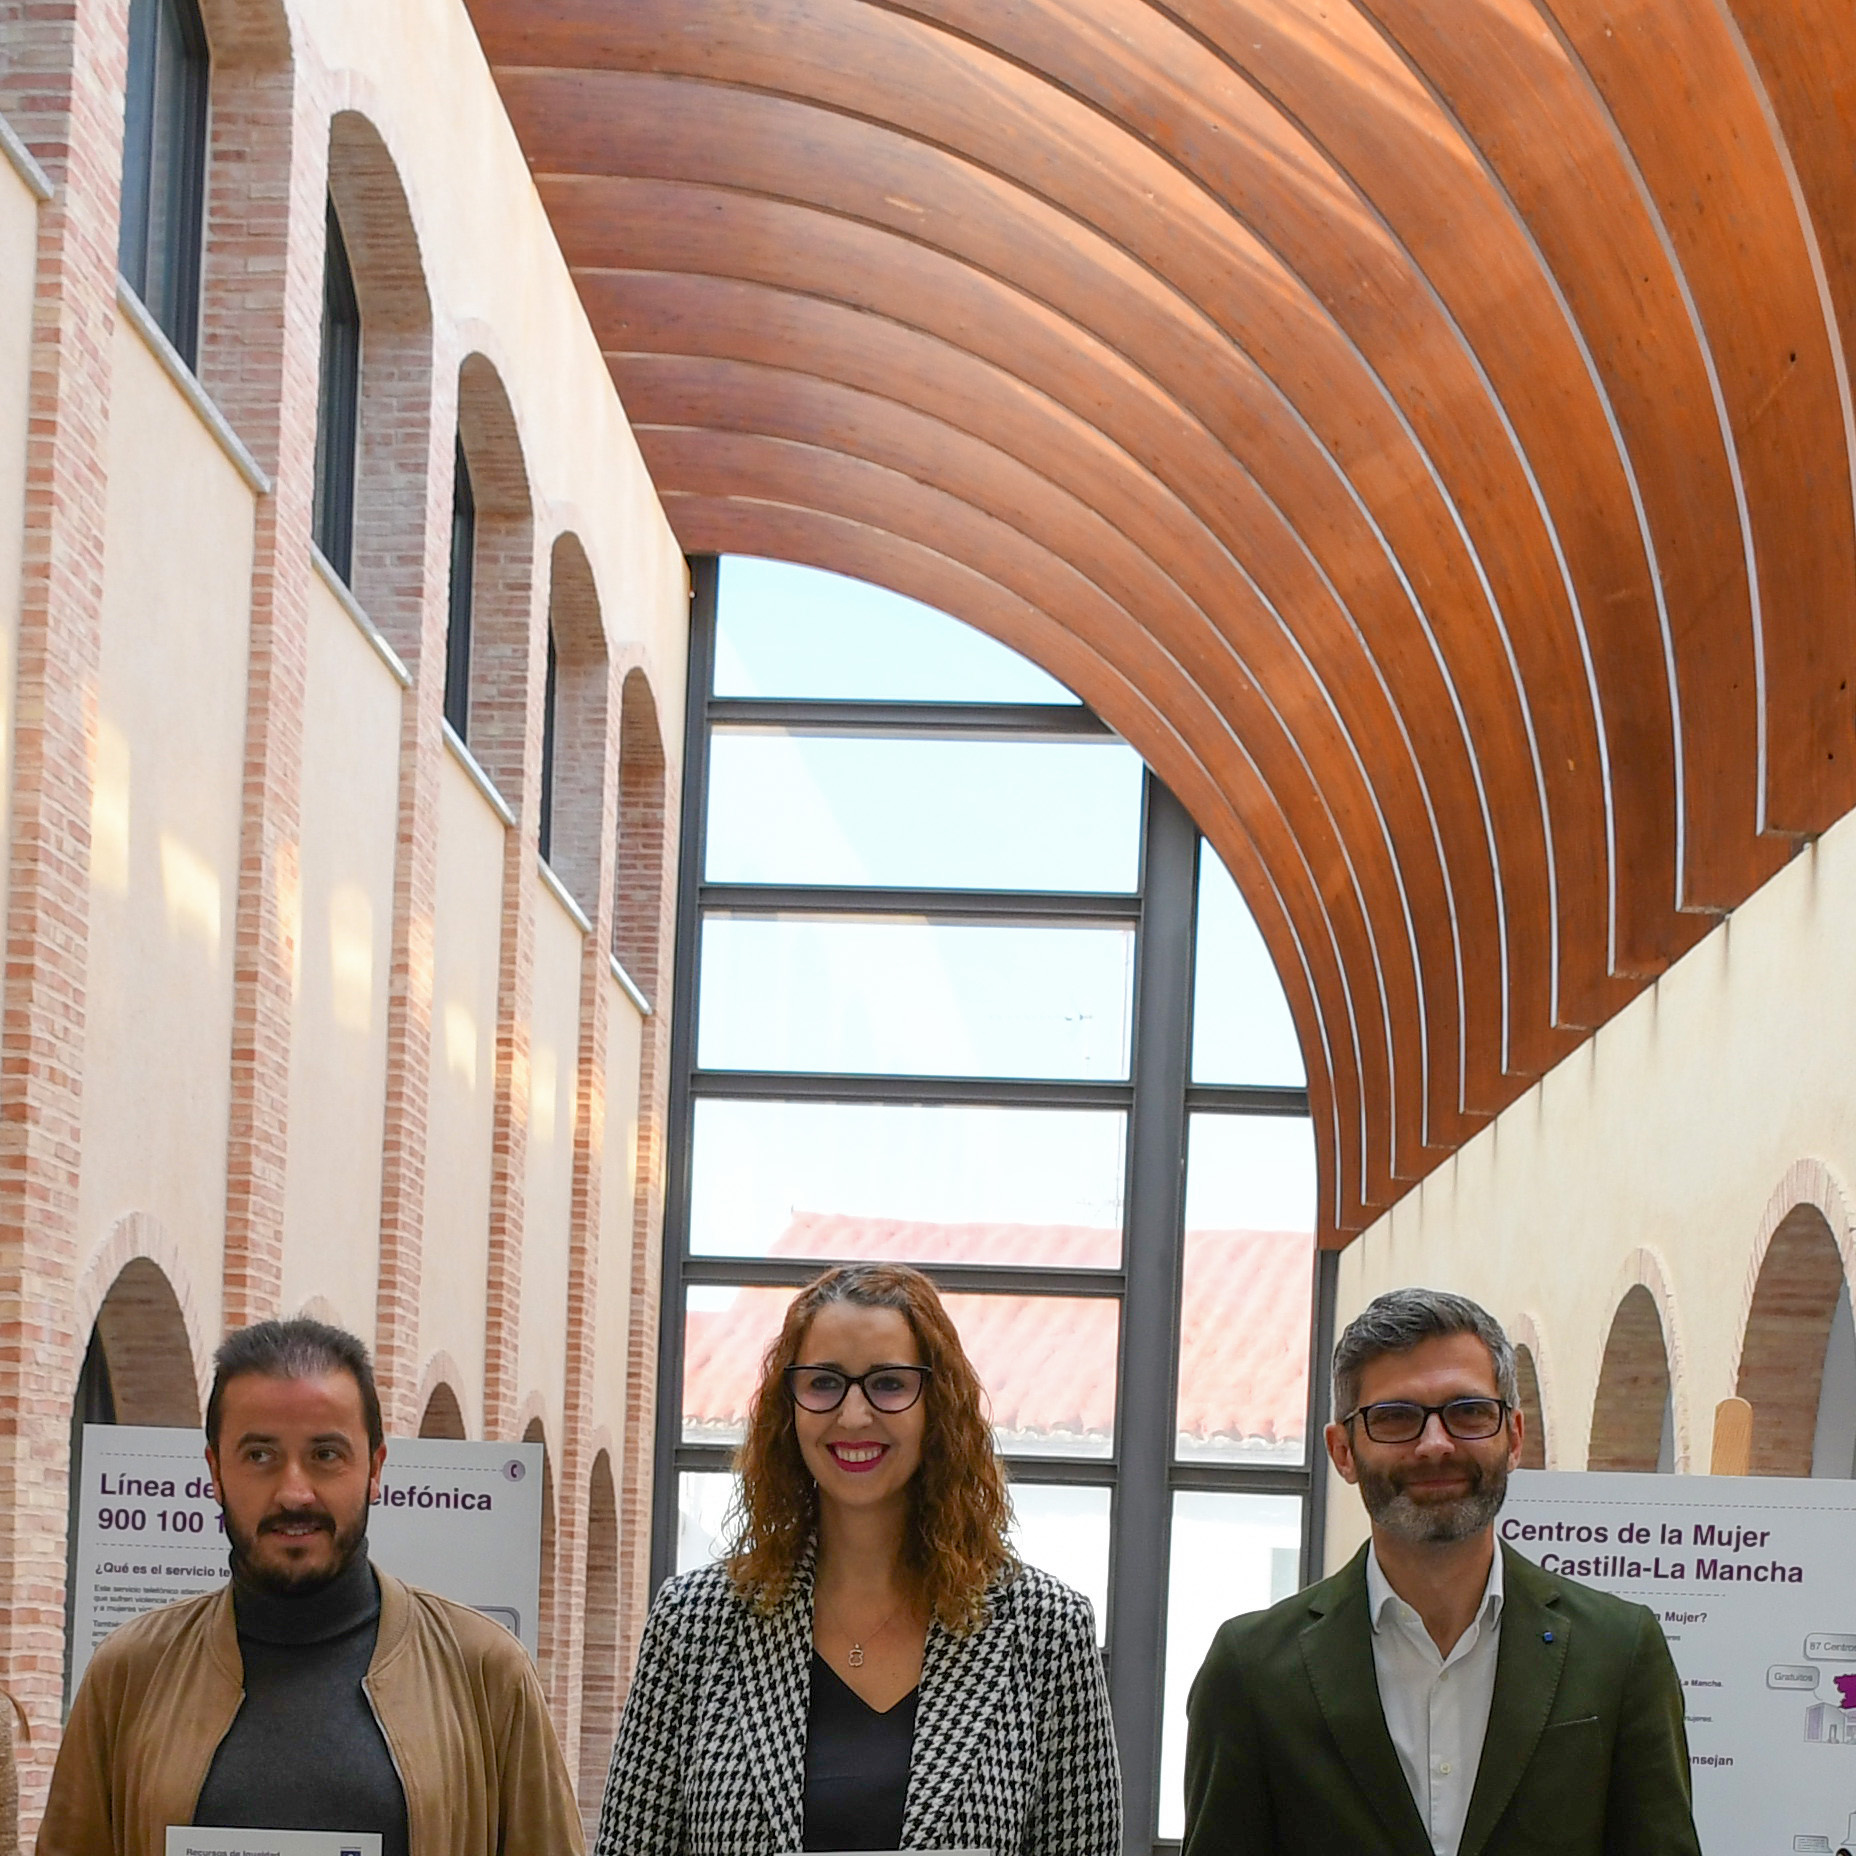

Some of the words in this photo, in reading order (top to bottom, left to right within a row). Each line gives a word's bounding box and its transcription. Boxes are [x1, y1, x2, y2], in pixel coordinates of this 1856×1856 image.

[100, 1472, 176, 1498] Línea
[184, 1477, 216, 1499] de
[370, 1485, 492, 1511] lefónica
[98, 1507, 147, 1531] 900
[156, 1510, 204, 1534] 100
[1501, 1518, 1609, 1543] Centros
[1617, 1522, 1651, 1545] de
[1660, 1523, 1683, 1546] la
[1692, 1524, 1771, 1553] Mujer
[95, 1561, 130, 1575] ¿Qué
[132, 1565, 148, 1575] es
[150, 1564, 162, 1575] el
[165, 1565, 216, 1577] servicio
[1539, 1553, 1685, 1580] Castilla-La
[1695, 1558, 1803, 1583] Mancha
[1664, 1611, 1708, 1625] Mujer?
[1809, 1641, 1822, 1651] 87
[1773, 1671, 1814, 1682] Gratuitos
